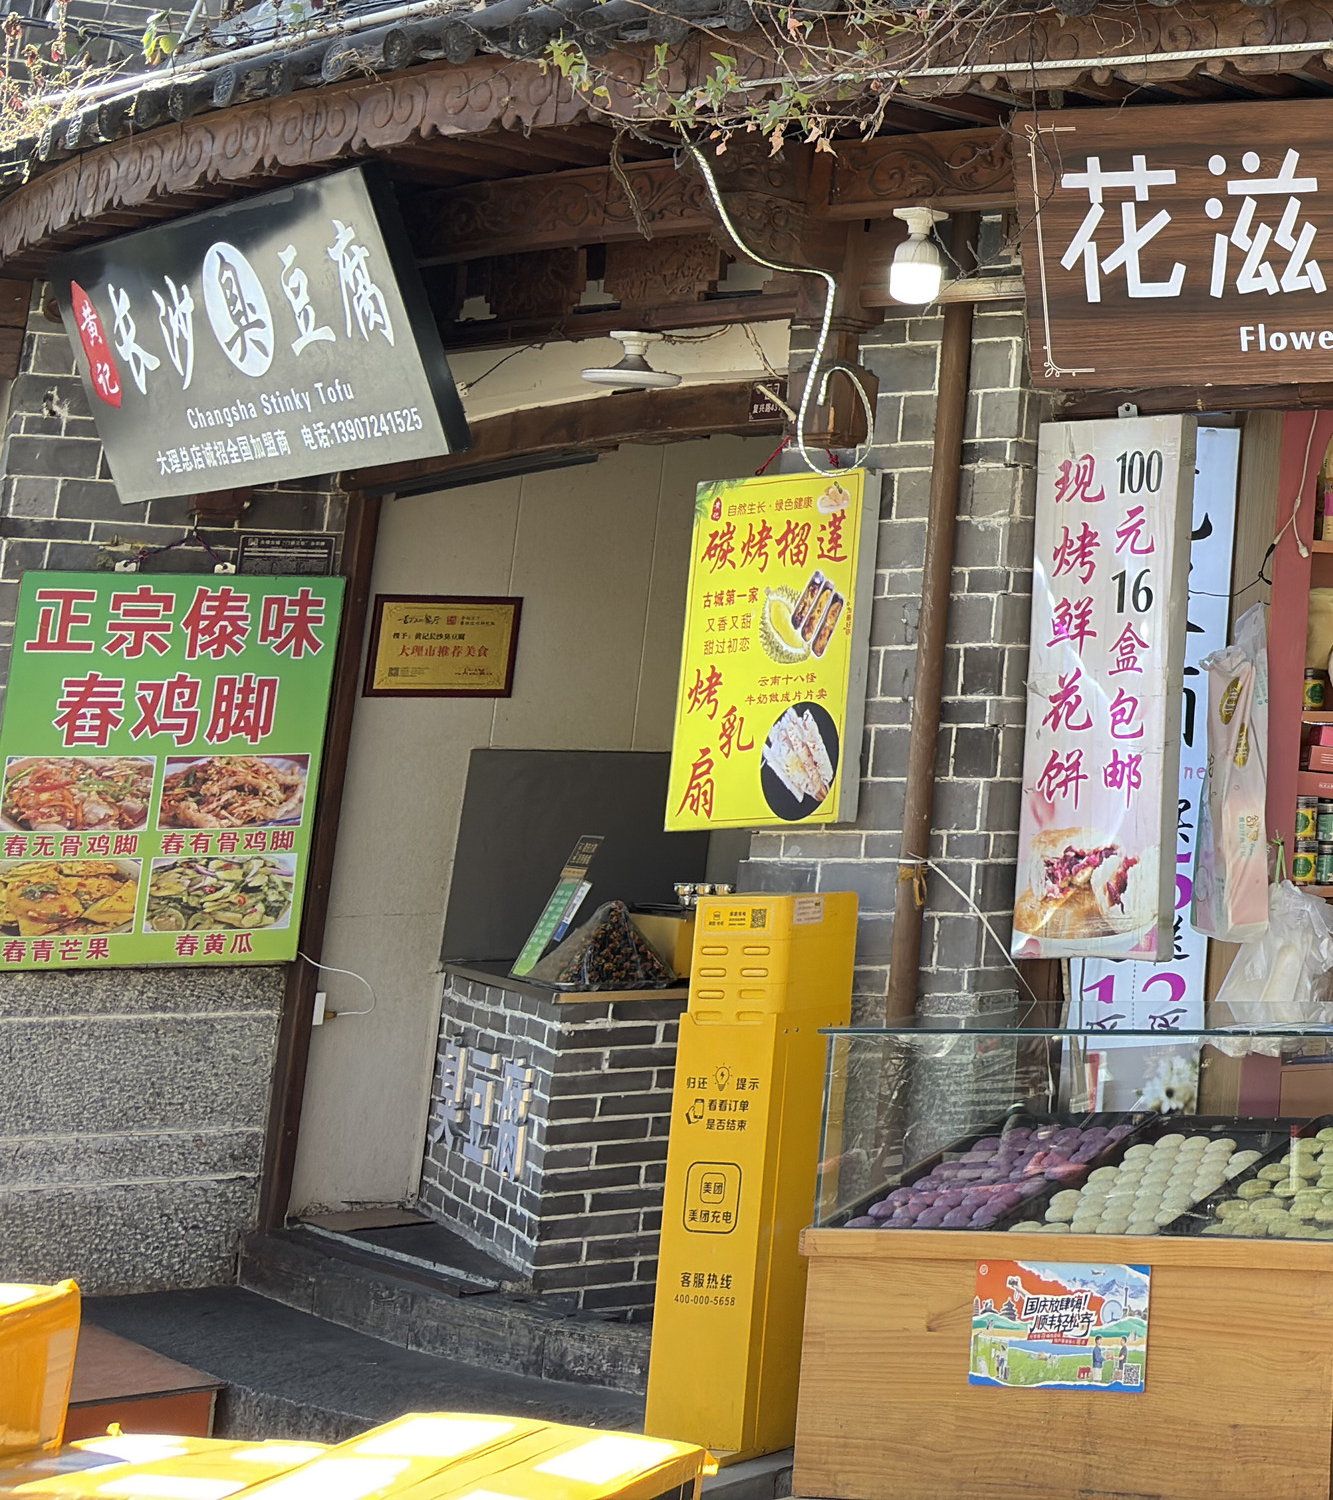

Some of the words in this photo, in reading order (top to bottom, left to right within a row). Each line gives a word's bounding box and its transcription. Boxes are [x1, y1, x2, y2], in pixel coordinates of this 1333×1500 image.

[109, 220, 394, 395] 长沙臭豆腐
[81, 301, 119, 396] 黄记
[186, 401, 258, 430] Changsha
[261, 387, 311, 417] Stinky
[314, 381, 354, 407] Tofu
[156, 429, 292, 476] 大理总店诚招全国加盟商
[703, 587, 759, 609] 古城第一家
[24, 586, 326, 660] 正宗傣味
[705, 614, 752, 633] 又香又甜
[1036, 453, 1105, 811] 现烤鲜花饼
[398, 644, 489, 658] 大理市推荐美食
[703, 637, 751, 656] 甜过初恋
[758, 673, 817, 687] 云南十八怪
[686, 1077, 708, 1090] 归还
[736, 1077, 760, 1091] 提示
[707, 1099, 750, 1112] 看看订单
[705, 1119, 748, 1132] 是否结束
[703, 1181, 723, 1195] 美团
[688, 1209, 732, 1224] 美团充电
[680, 1272, 733, 1290] 客服热线
[674, 1294, 736, 1307] 400-000-5658
